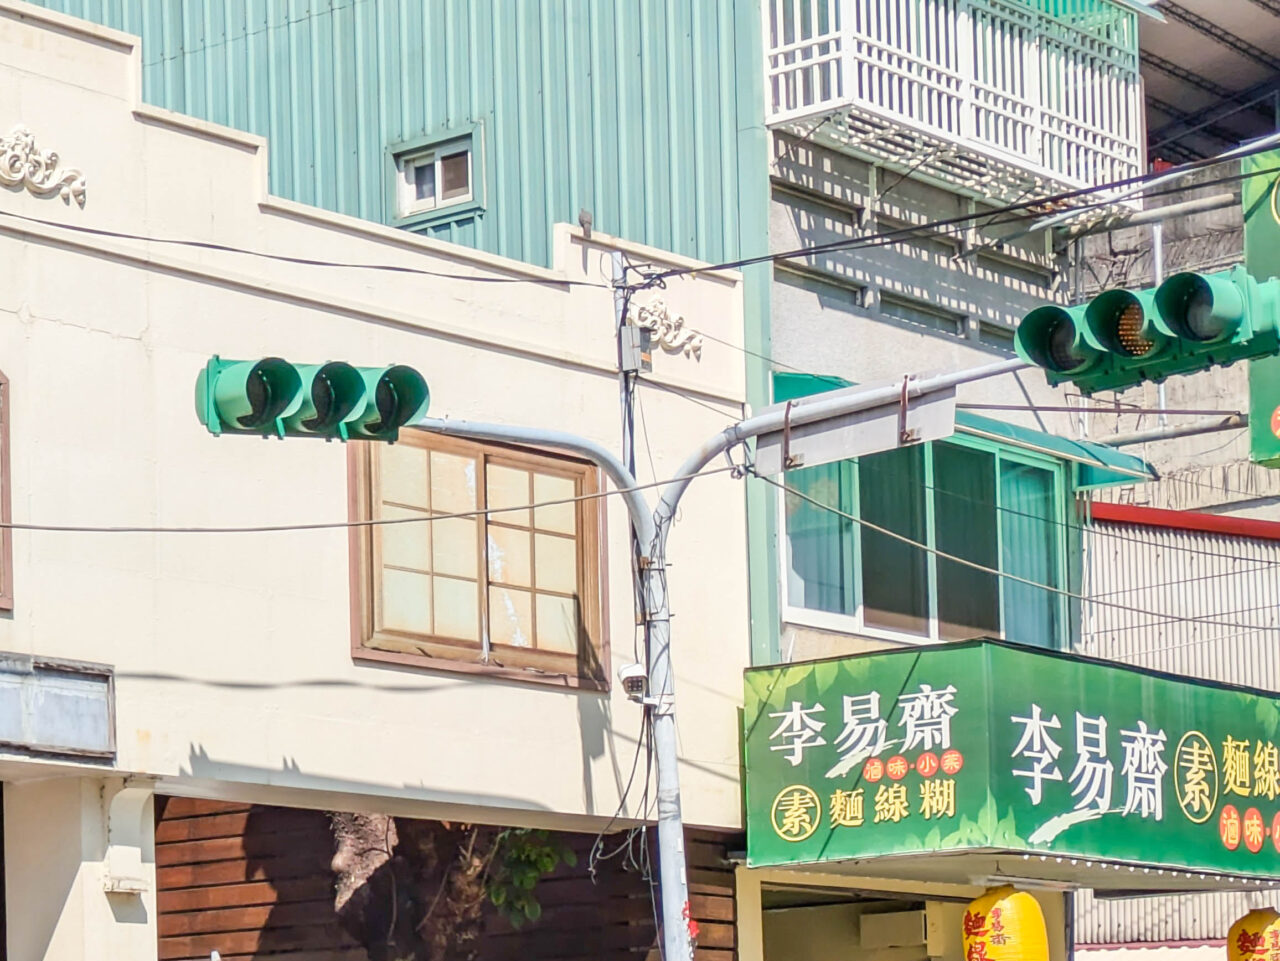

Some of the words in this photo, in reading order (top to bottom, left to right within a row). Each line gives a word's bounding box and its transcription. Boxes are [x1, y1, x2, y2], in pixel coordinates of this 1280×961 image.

[768, 684, 959, 767] 李易齋
[1010, 703, 1168, 822] 李易齋
